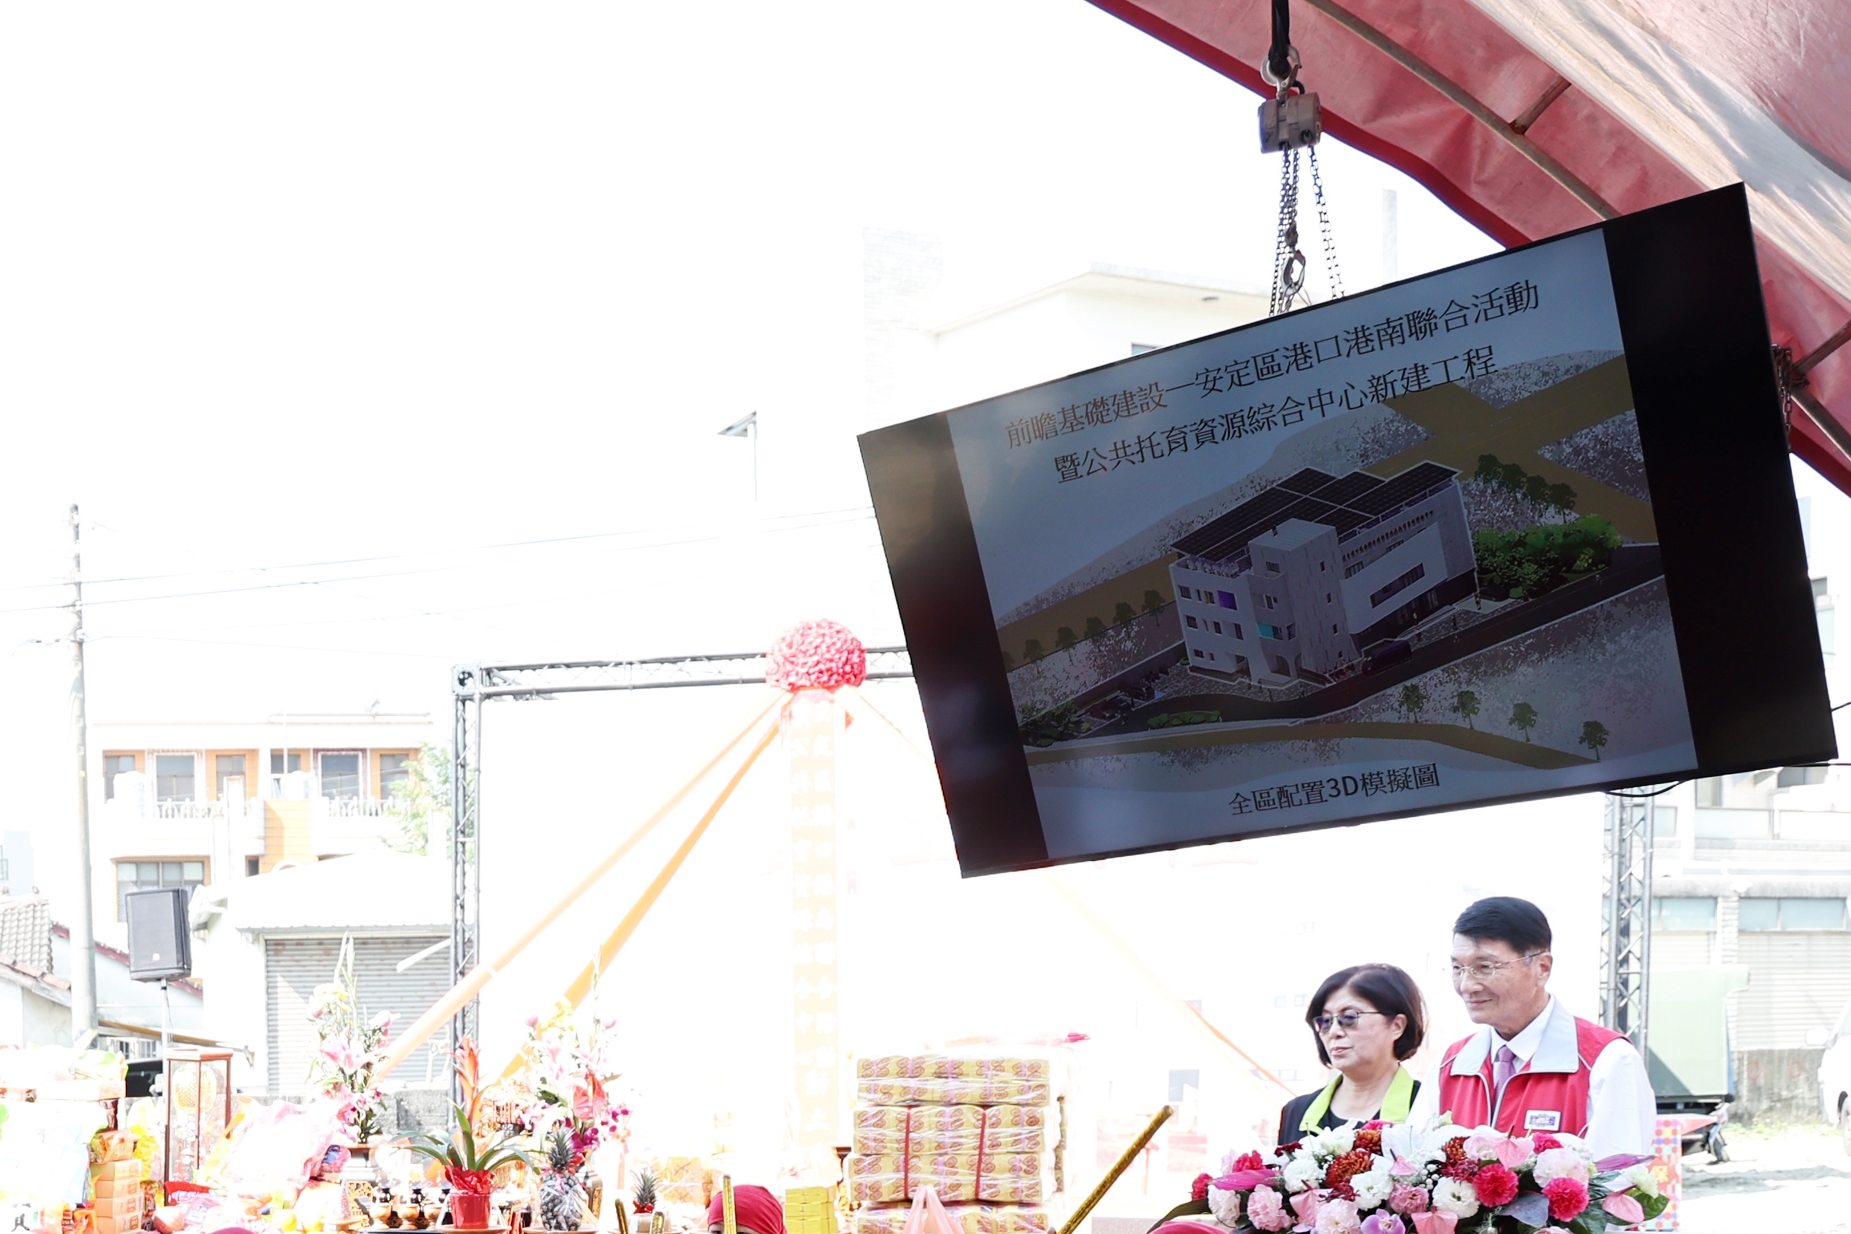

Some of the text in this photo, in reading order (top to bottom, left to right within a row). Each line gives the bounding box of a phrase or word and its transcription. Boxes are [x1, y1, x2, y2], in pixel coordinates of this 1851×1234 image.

[1054, 344, 1499, 484] 暨公共托育資源綜合中心新建工程
[1228, 762, 1441, 816] 全區配置3D模擬圖
